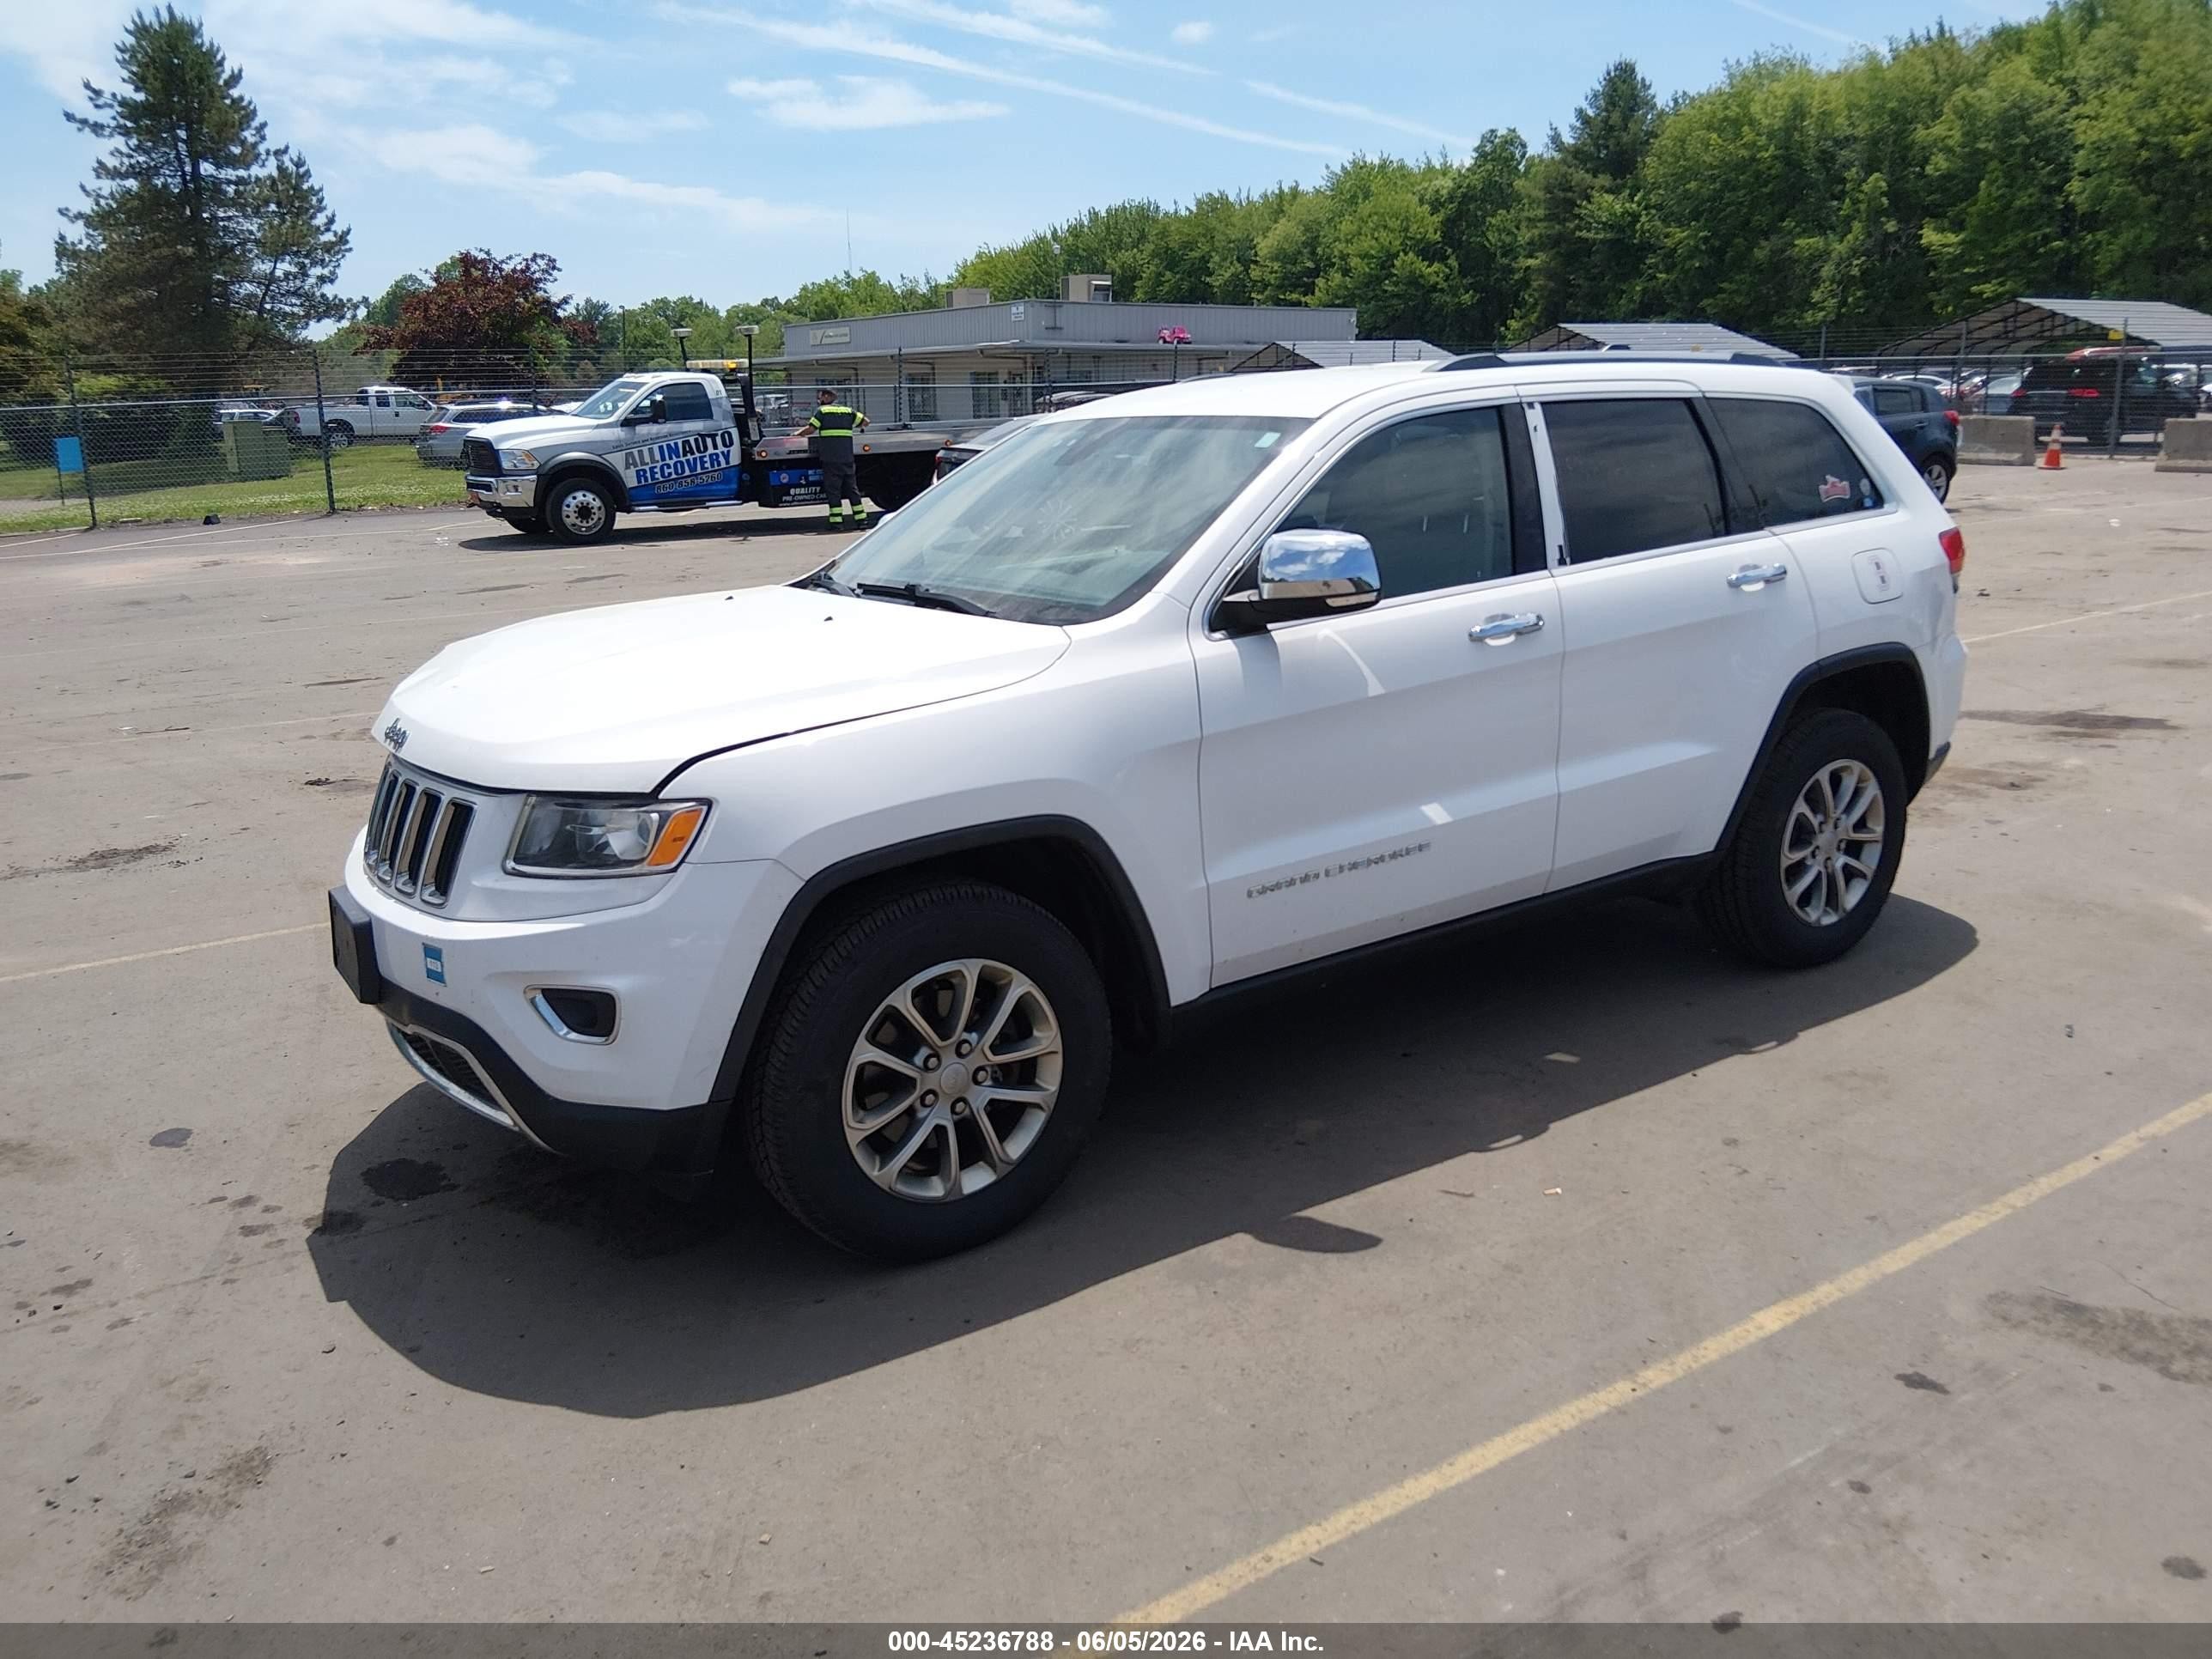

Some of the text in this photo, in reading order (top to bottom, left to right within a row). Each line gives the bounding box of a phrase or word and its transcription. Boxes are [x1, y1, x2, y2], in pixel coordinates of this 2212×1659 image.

[635, 449, 731, 485] RECOVERY
[790, 486, 821, 495] QUALITY
[385, 718, 410, 750] Jeep
[1324, 842, 1431, 878] CHEROKEE
